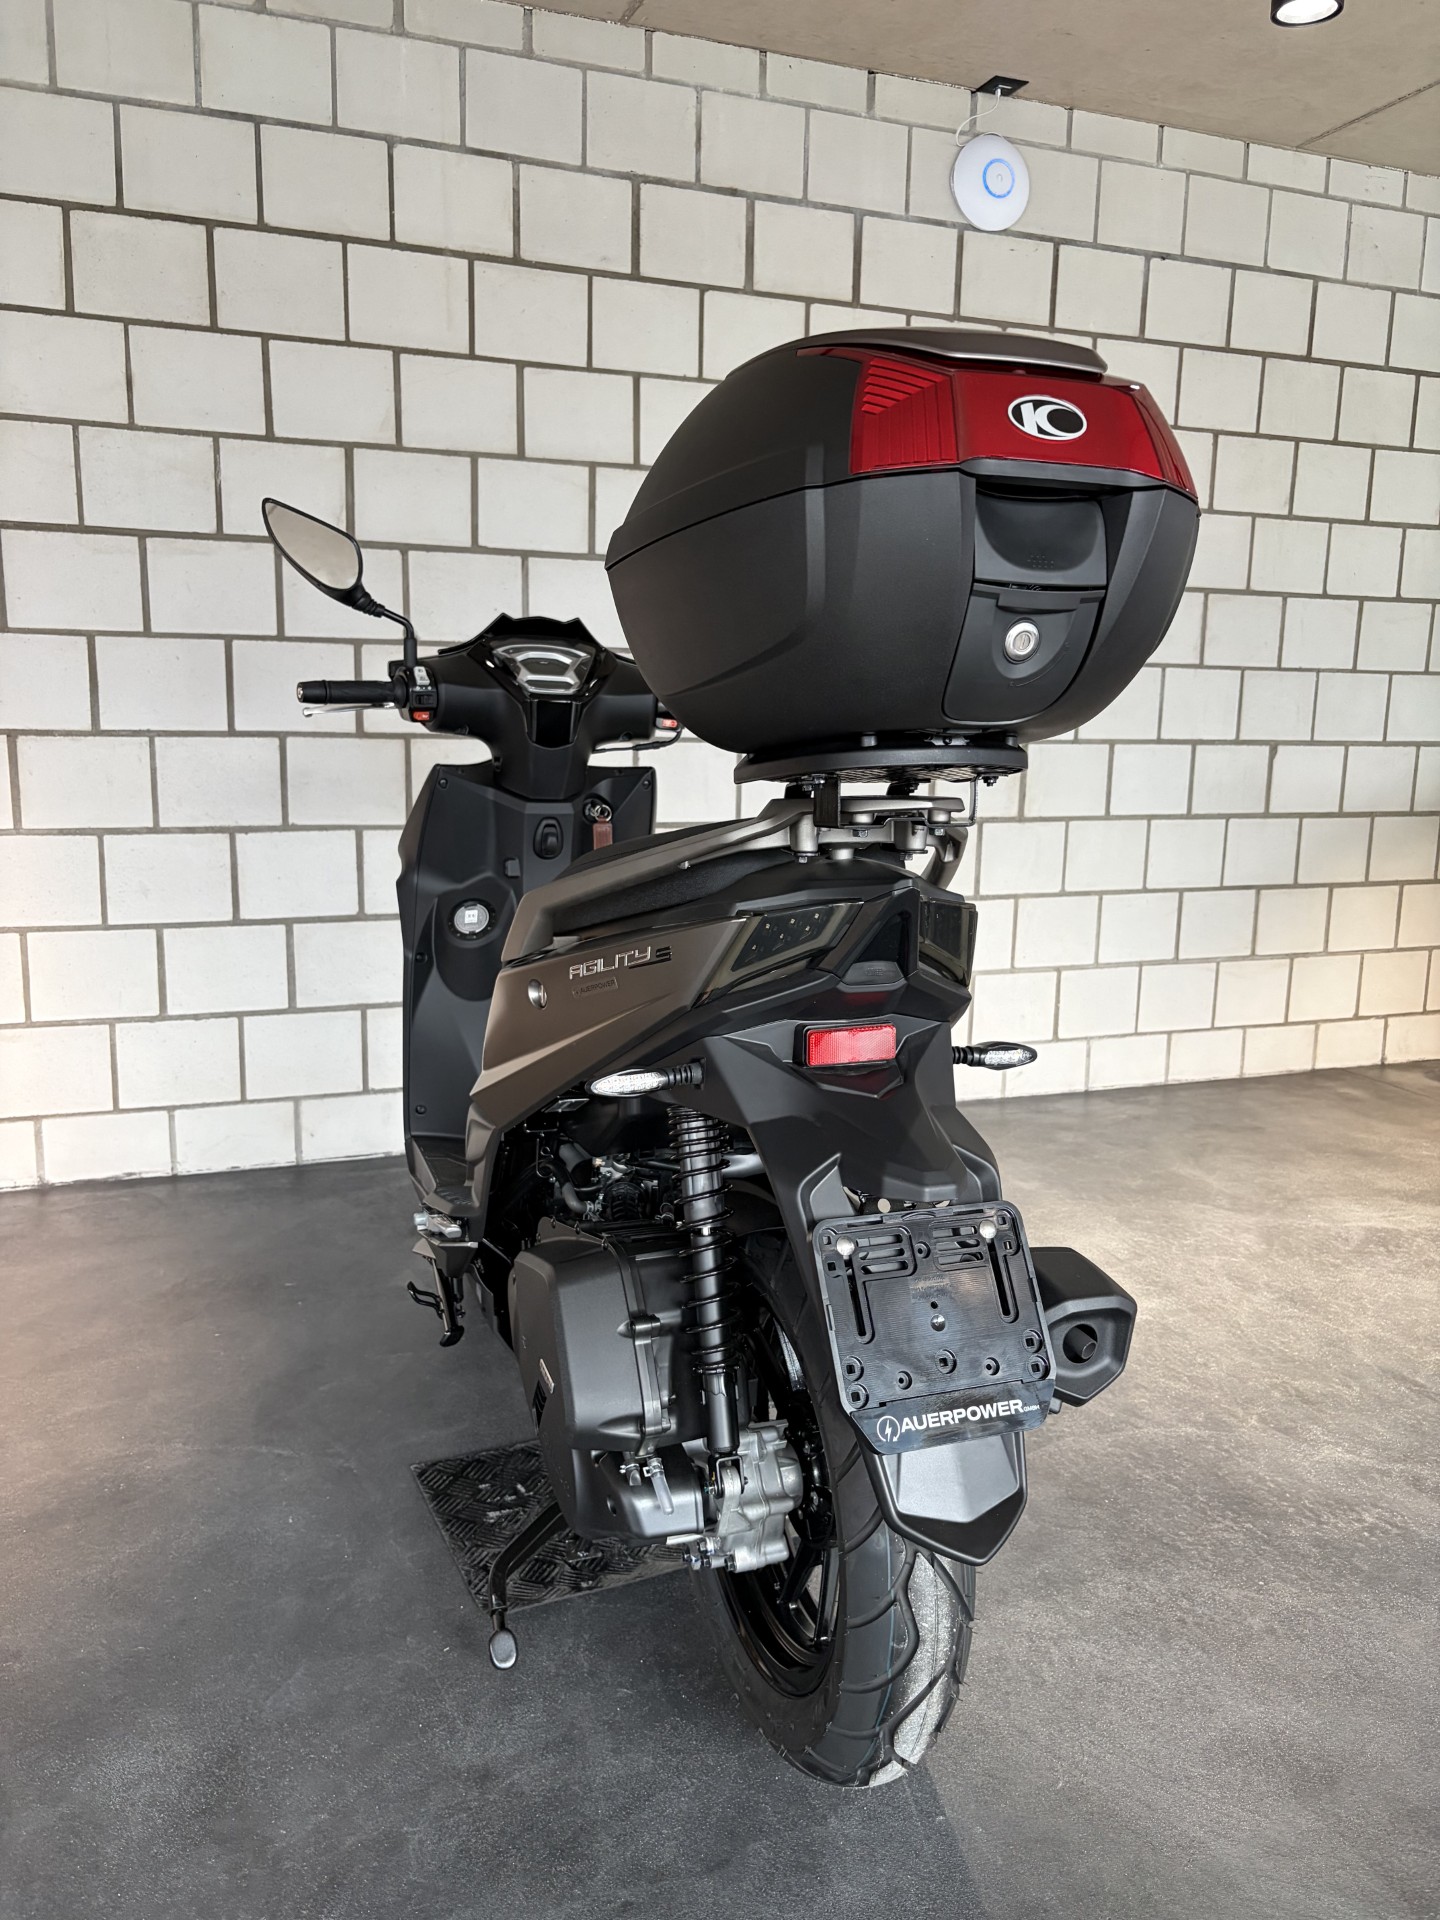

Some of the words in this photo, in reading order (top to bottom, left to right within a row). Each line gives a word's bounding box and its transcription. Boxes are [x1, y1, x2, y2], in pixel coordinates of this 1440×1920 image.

[569, 946, 651, 980] AGILITY
[580, 979, 616, 994] AUERPOWER
[901, 1399, 1024, 1433] AUERPOWER
